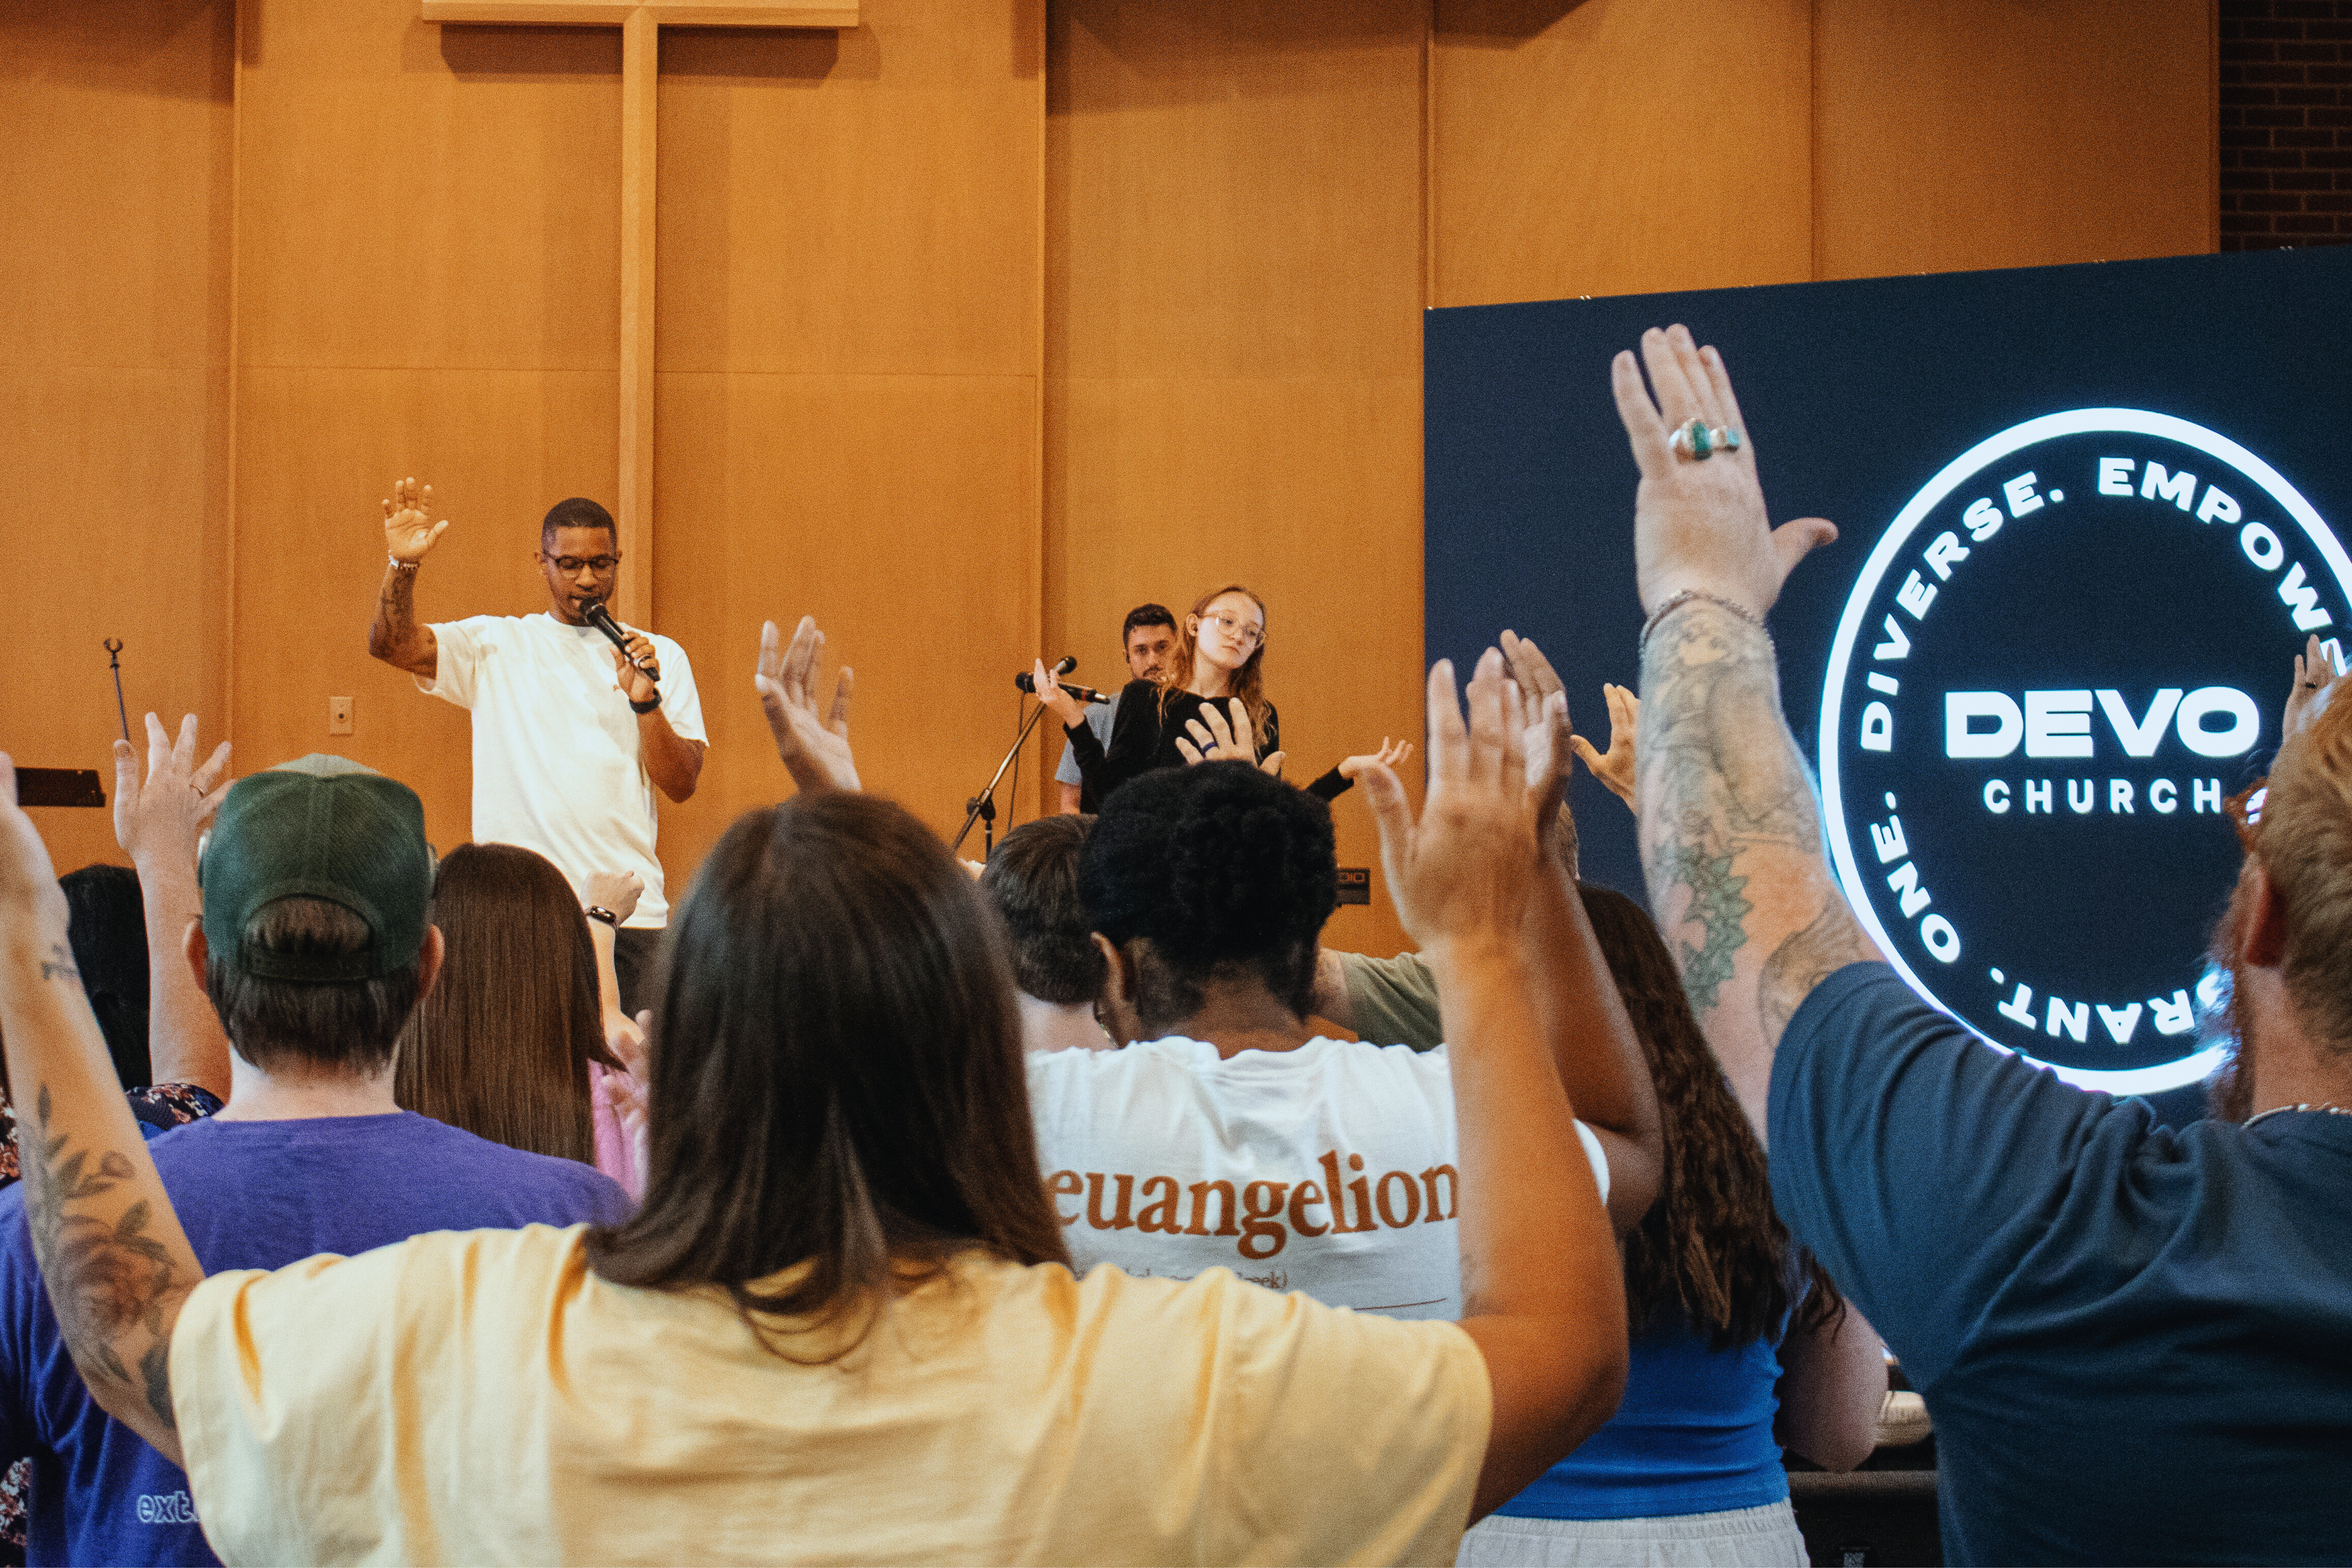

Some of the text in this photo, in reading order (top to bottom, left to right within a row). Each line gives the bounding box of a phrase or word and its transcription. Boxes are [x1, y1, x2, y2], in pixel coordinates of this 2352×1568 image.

[1860, 470, 2065, 753] DIVERSE.
[1945, 687, 2260, 759] DEVO
[1984, 778, 2222, 815] CHURCH
[1870, 790, 1962, 964] ONE.
[1044, 1149, 1458, 1260] euangelion
[136, 1490, 200, 1524] ext
